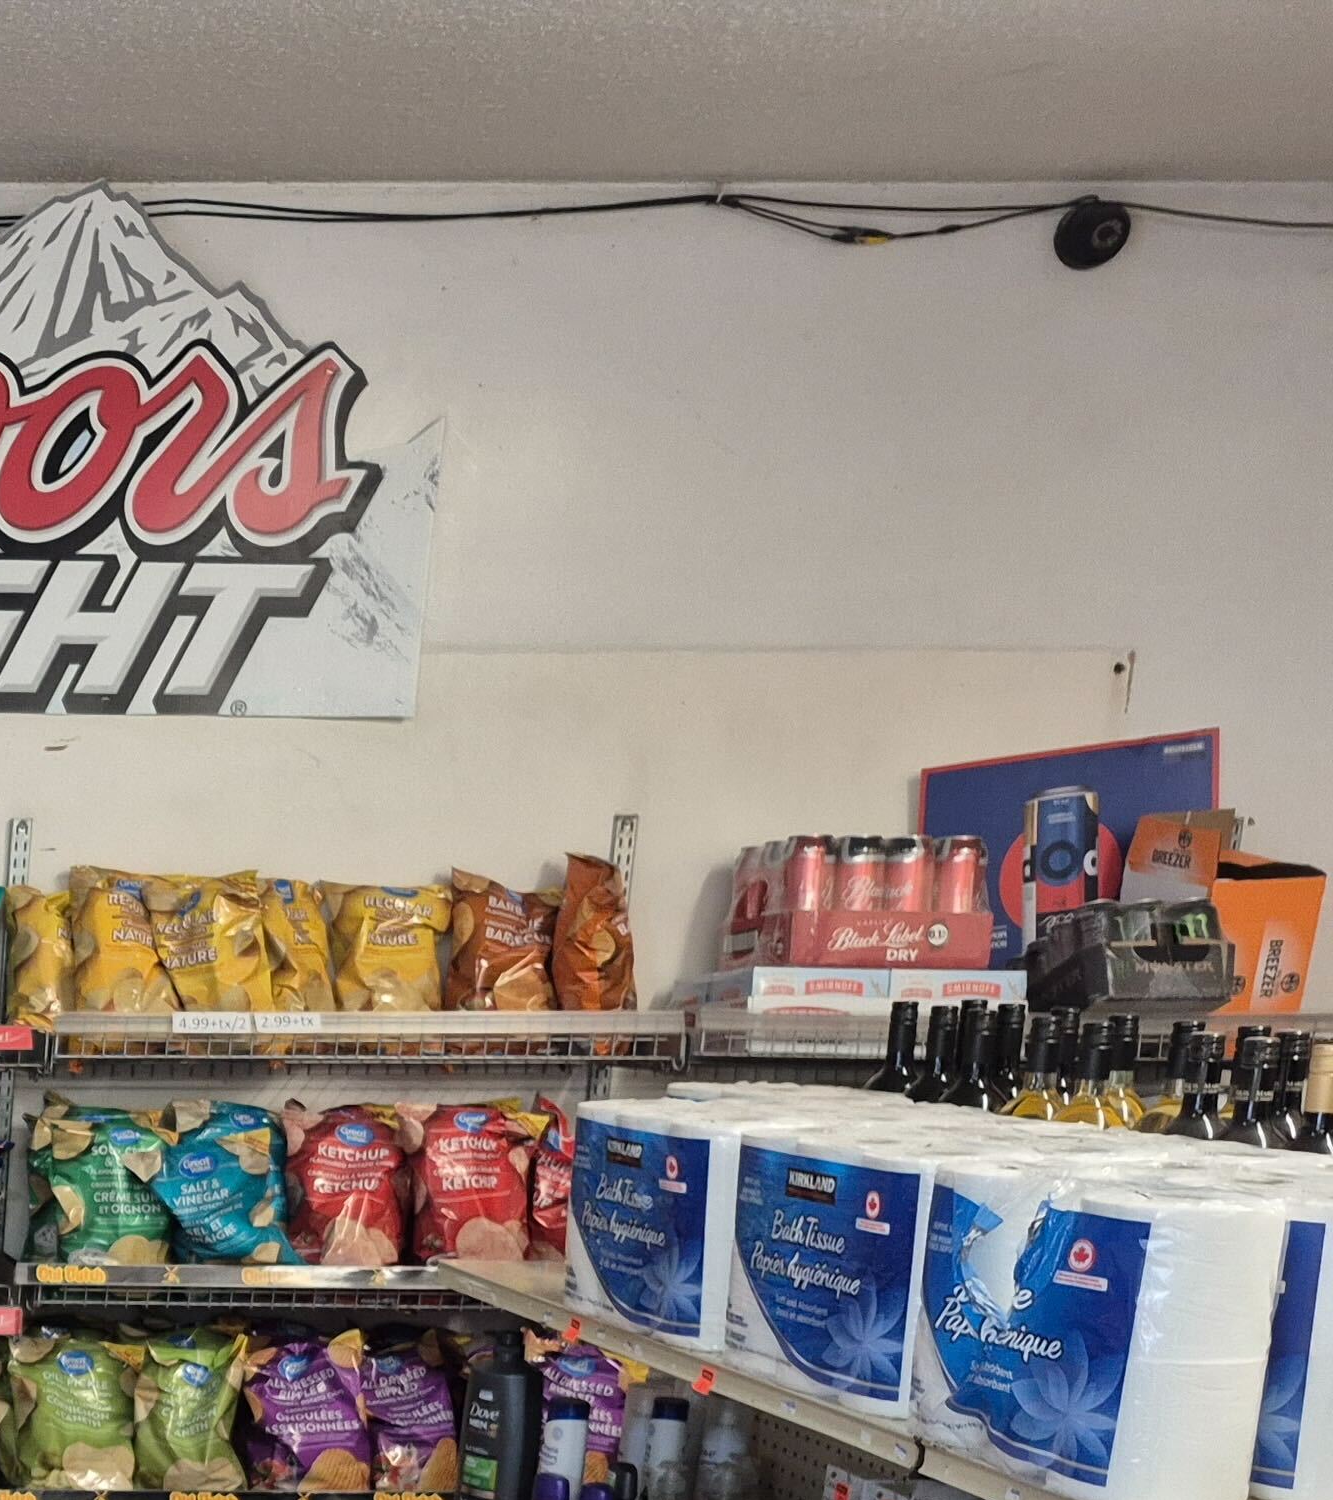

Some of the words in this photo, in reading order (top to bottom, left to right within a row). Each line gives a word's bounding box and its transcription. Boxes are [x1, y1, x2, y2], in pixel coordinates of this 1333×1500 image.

[1152, 848, 1192, 868] BREEZER
[829, 926, 879, 950] Black
[880, 918, 925, 947] Label
[886, 948, 919, 962] DRY
[1260, 939, 1285, 999] BREEZER
[944, 982, 998, 995] SMIRNOFF
[317, 1144, 389, 1162] KETCHUP
[606, 1141, 642, 1159] KIRKLAND
[789, 1172, 835, 1195] KIRKLAND
[172, 1188, 229, 1207] VINEGAR
[772, 1211, 803, 1243] Bath
[803, 1216, 846, 1253] Tissue
[751, 1245, 786, 1279] Papier
[784, 1257, 862, 1296] hygiénique
[469, 1405, 500, 1423] Dove
